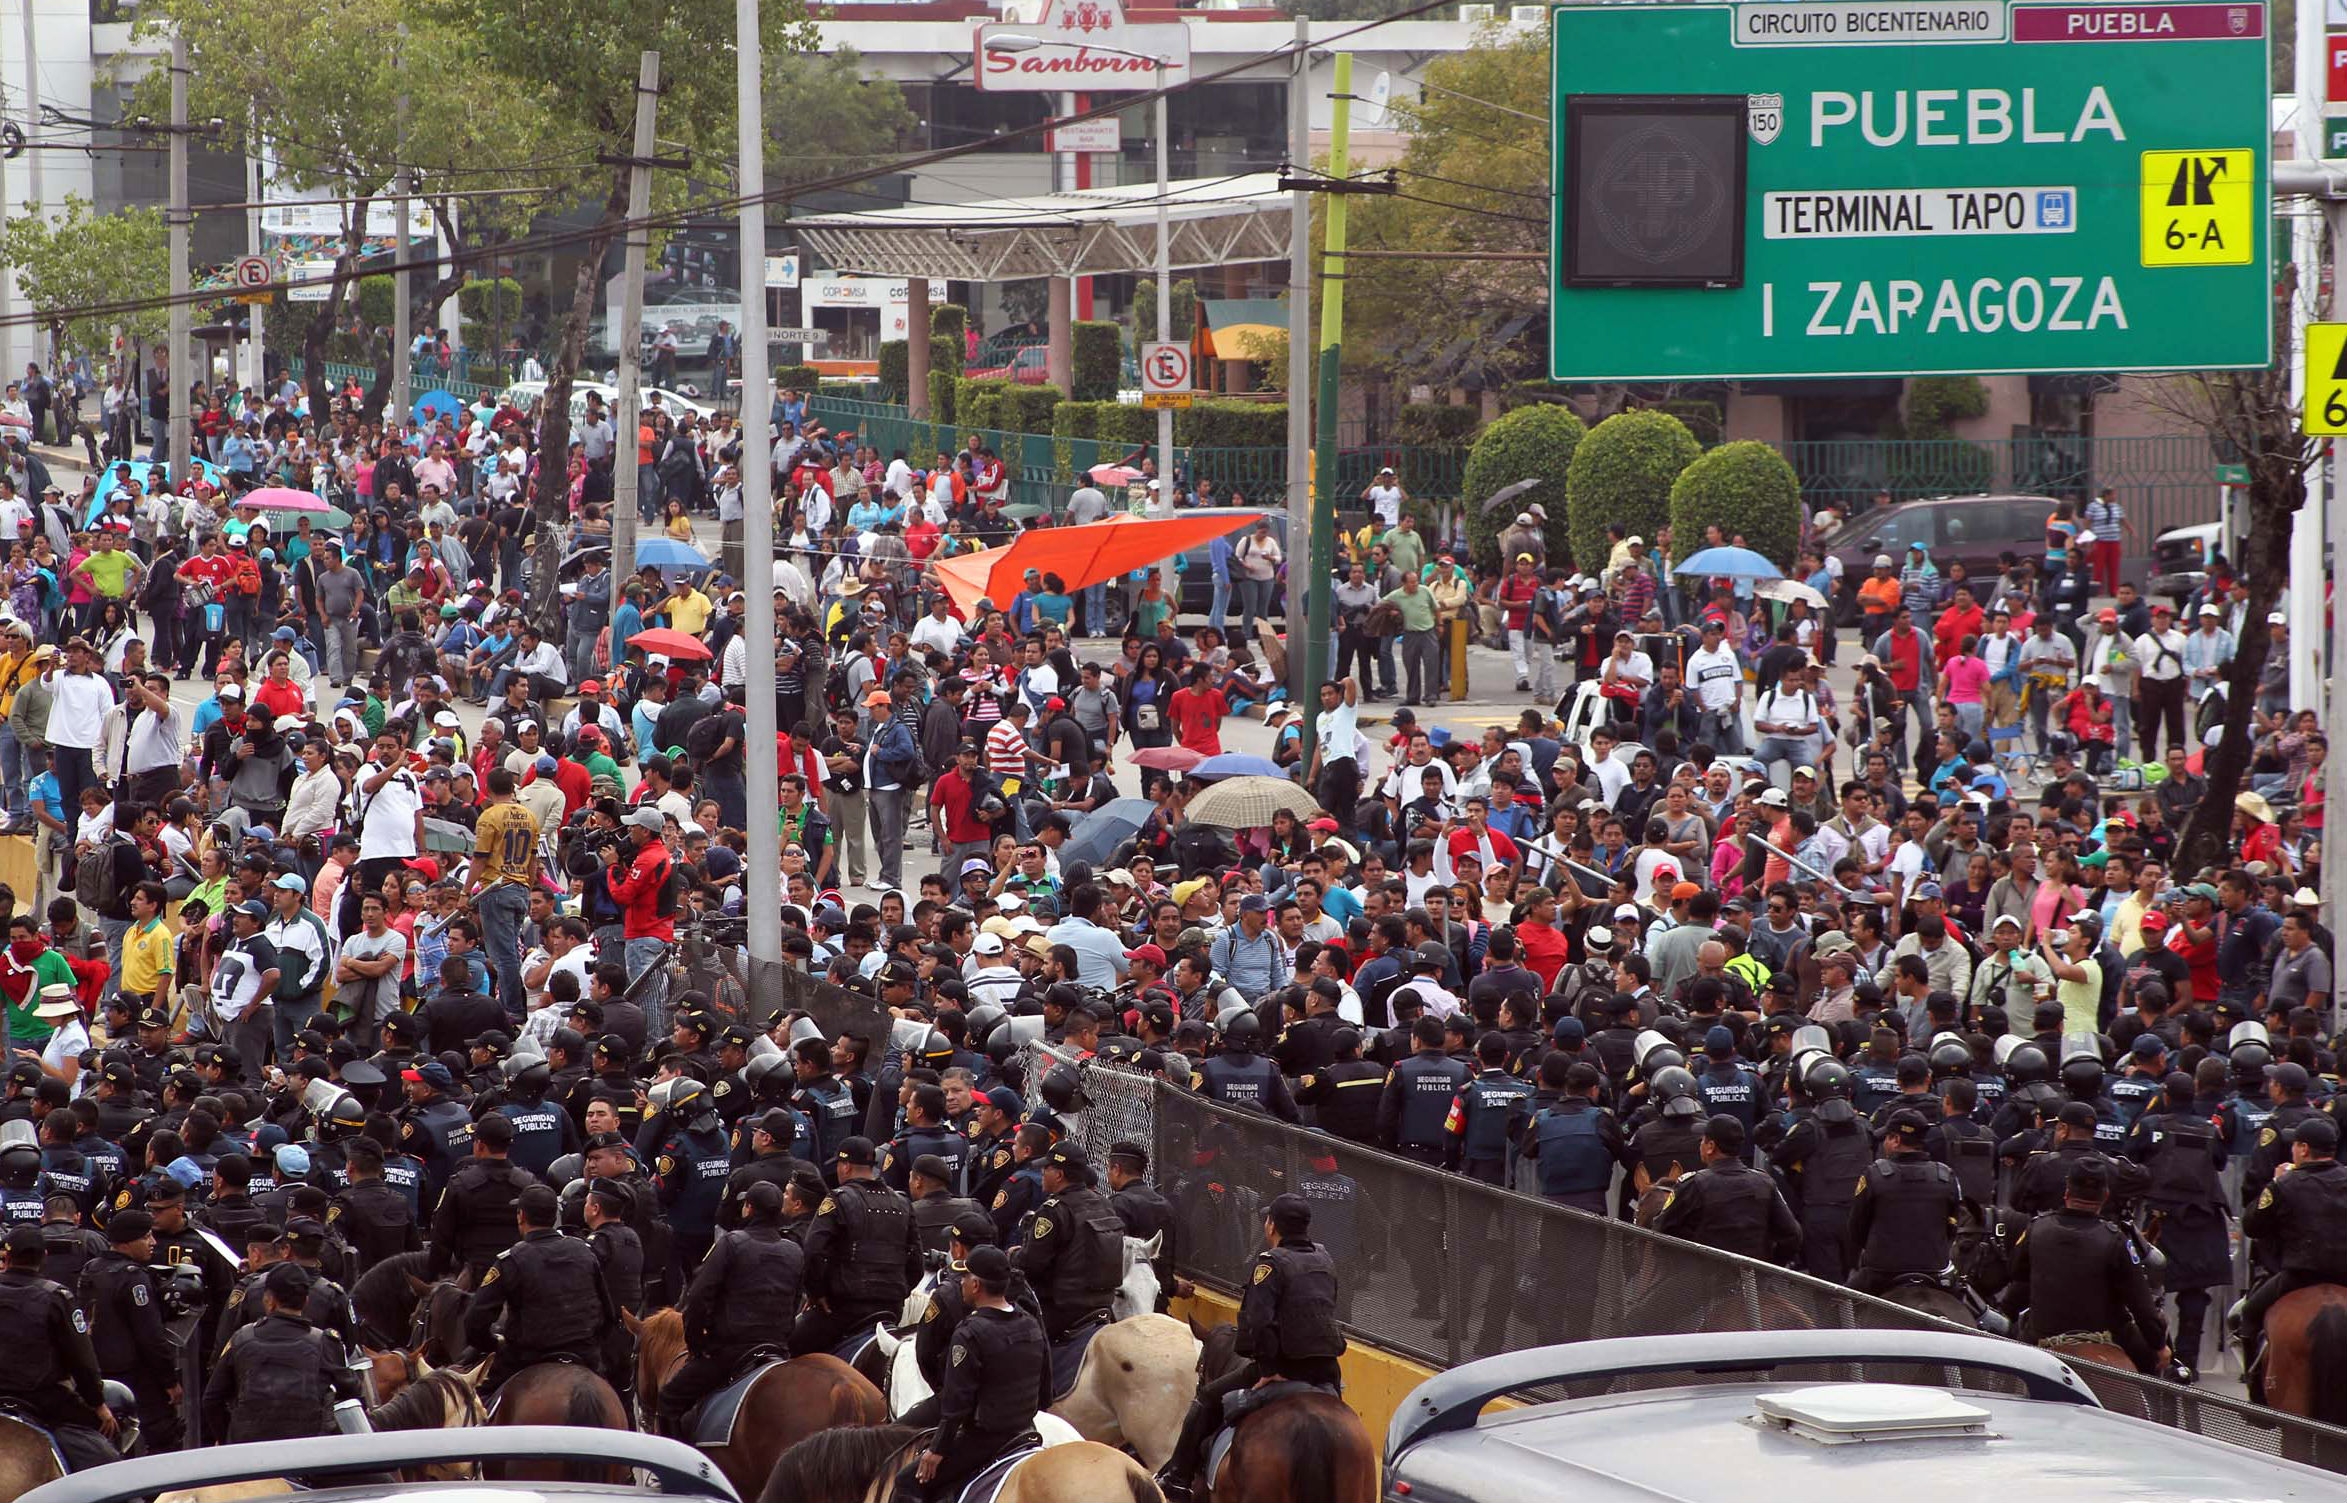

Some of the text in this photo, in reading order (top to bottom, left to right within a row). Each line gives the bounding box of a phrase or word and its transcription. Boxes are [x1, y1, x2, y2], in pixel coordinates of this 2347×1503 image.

[1748, 9, 1990, 34] CIRCUITO BICENTENARIO
[2067, 13, 2175, 34] PUEBLA
[1752, 113, 1778, 132] 150
[1810, 86, 2127, 147] PUEBLA
[1774, 192, 2025, 233] TERMINAL TAPO
[2164, 217, 2225, 250] 6-A
[504, 828, 532, 865] 10
[1418, 952, 1426, 960] TV
[1705, 1086, 1750, 1095] SEGURIDAD
[1711, 1094, 1746, 1103] PUBLICA
[512, 1114, 556, 1125] SEGURIDAD
[519, 1123, 553, 1132] PUBLICA
